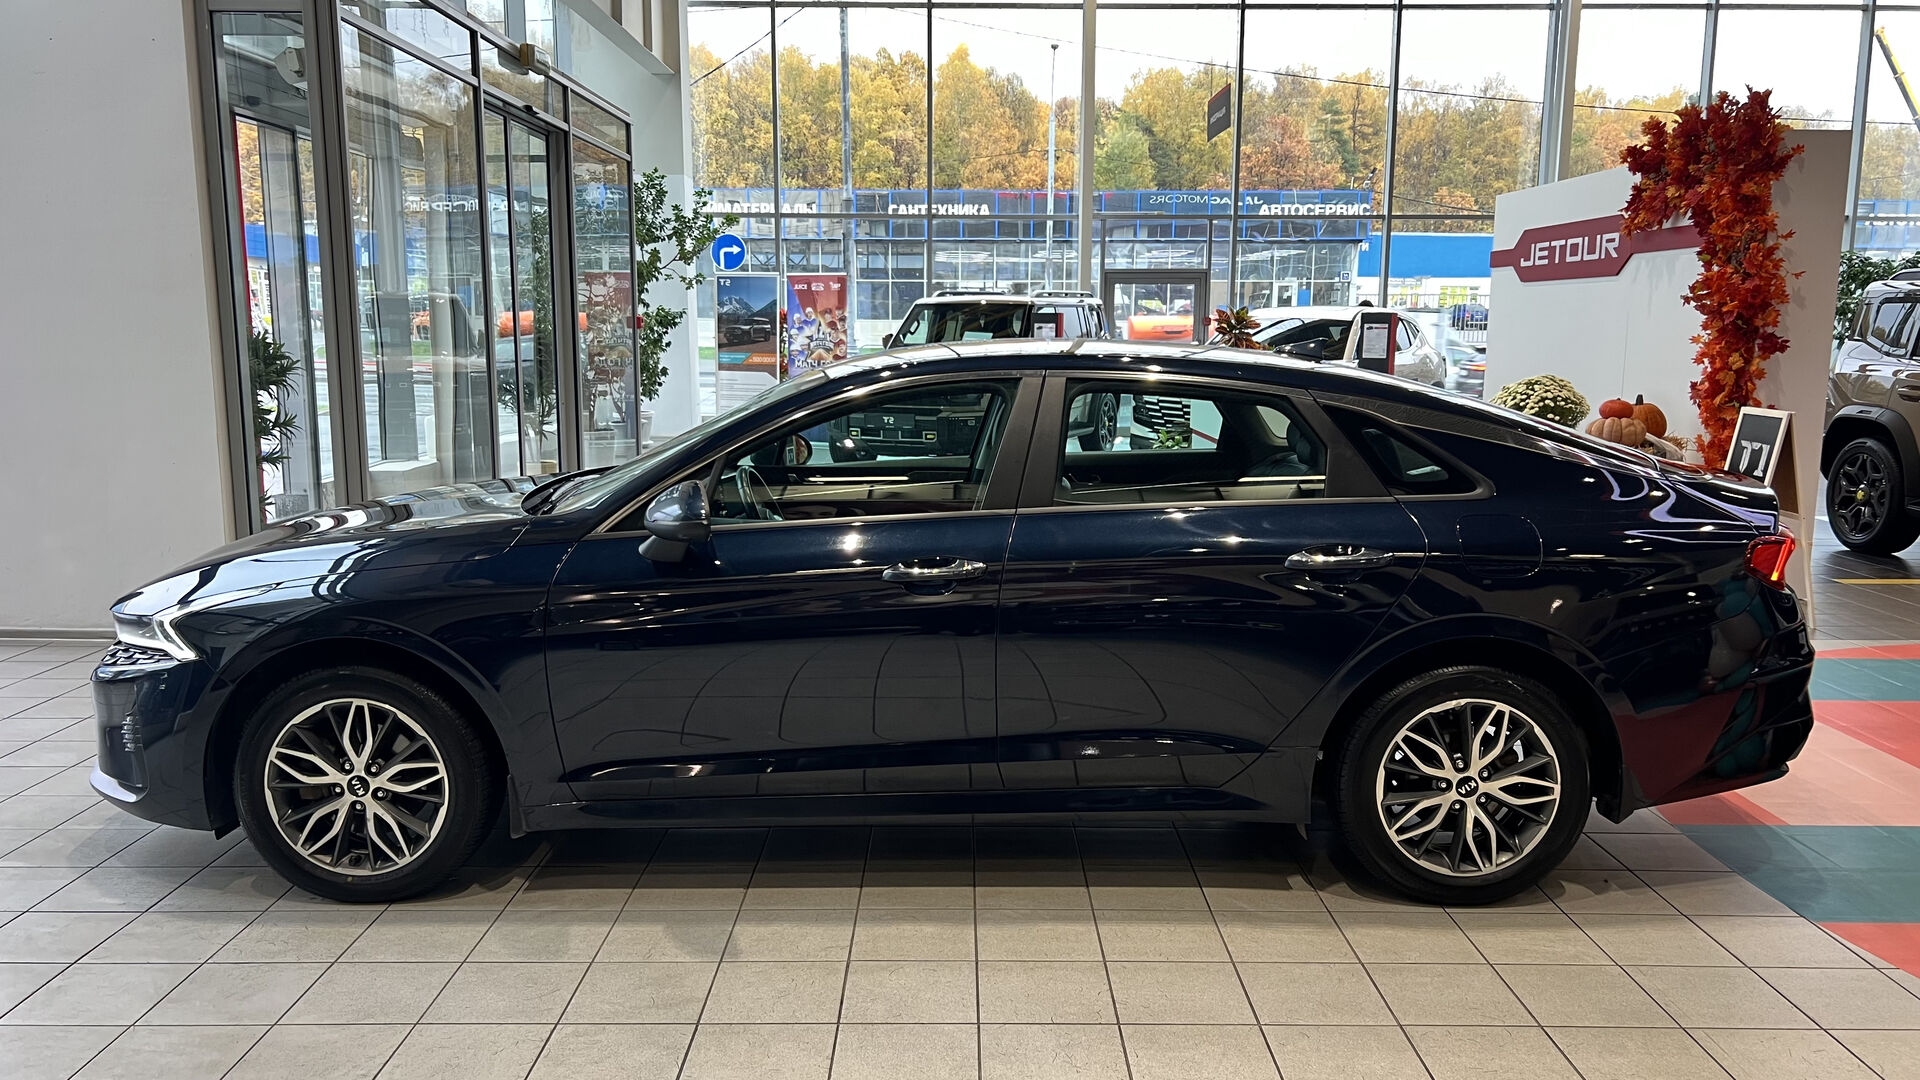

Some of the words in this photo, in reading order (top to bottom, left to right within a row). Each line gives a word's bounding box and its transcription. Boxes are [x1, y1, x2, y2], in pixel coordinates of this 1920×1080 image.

[1258, 203, 1371, 216] АВТОСЕРВИС
[1520, 232, 1620, 267] JETOUR
[351, 777, 366, 796] KIA
[1457, 779, 1477, 794] KIA
